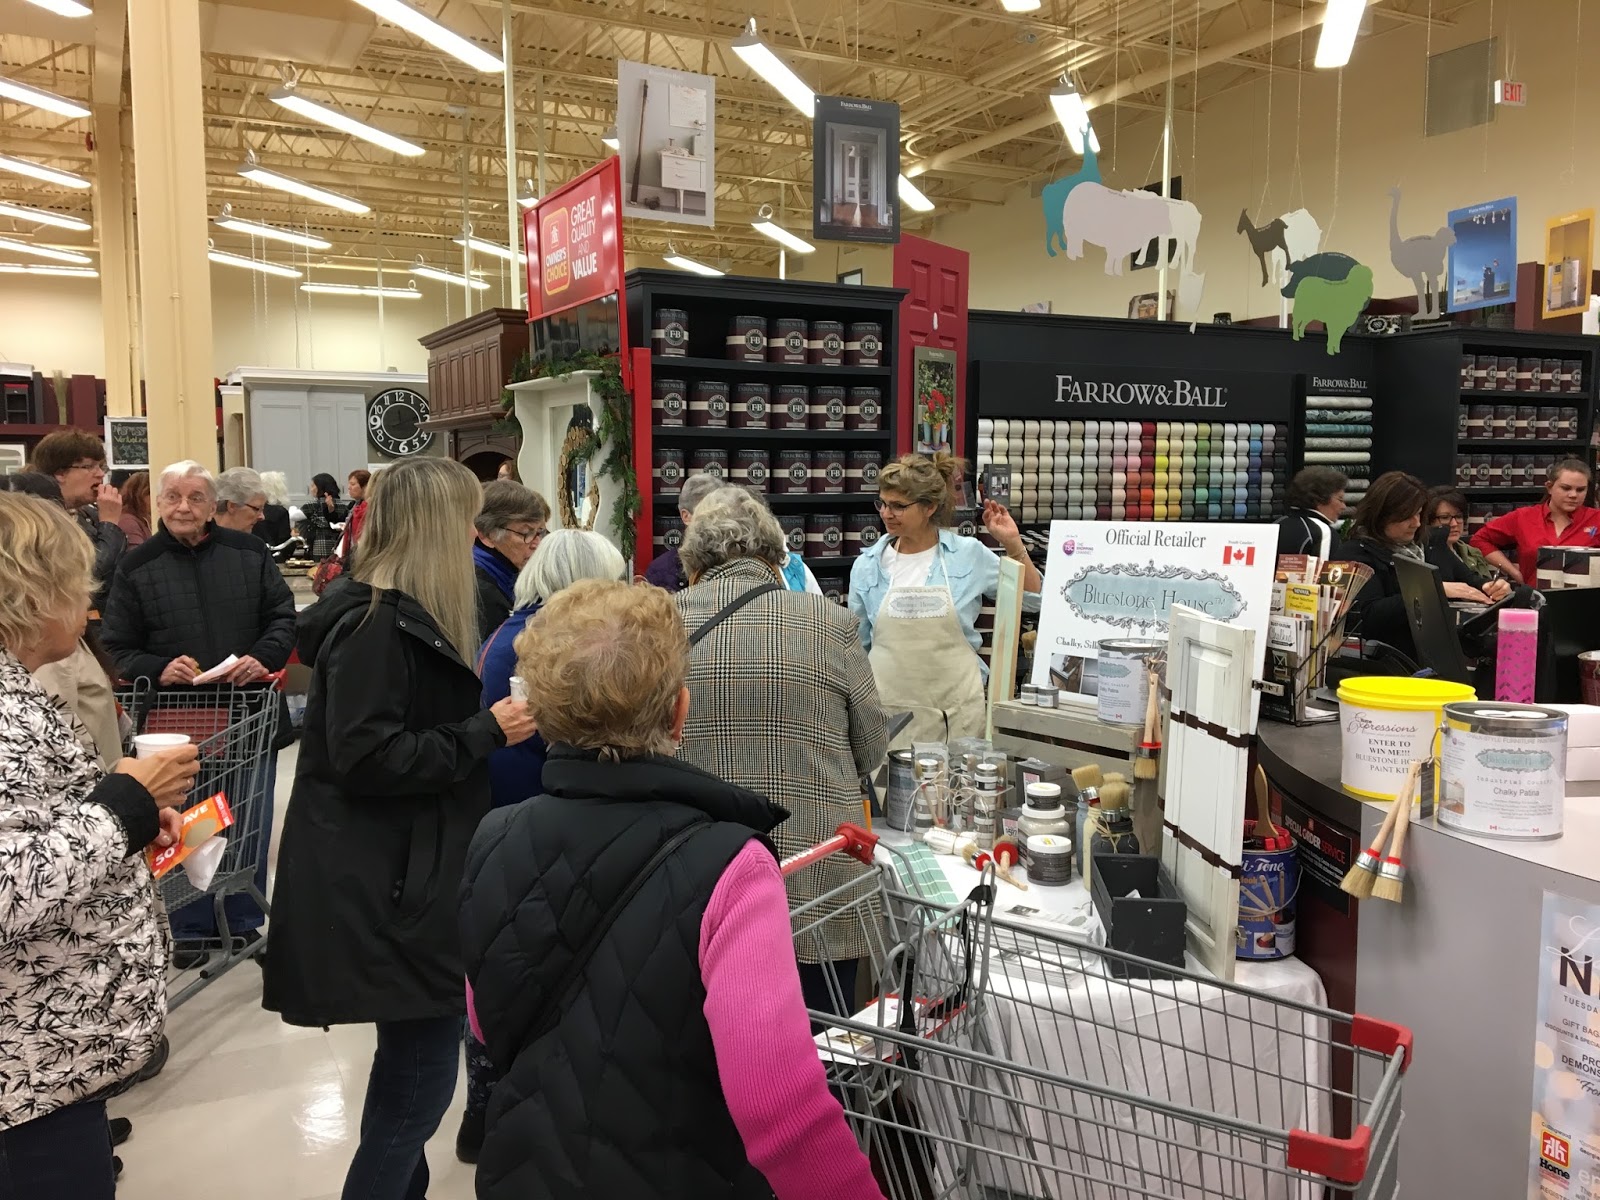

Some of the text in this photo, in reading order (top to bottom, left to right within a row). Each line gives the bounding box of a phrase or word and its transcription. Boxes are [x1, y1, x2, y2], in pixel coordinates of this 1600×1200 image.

[1504, 83, 1522, 102] EXIT
[571, 196, 596, 226] GREAT
[571, 219, 596, 244] QUALITY
[577, 241, 590, 256] AND
[545, 260, 568, 283] CHOICE
[572, 252, 598, 280] VALUE
[1312, 376, 1368, 389] FARROW&BALL
[395, 391, 405, 402] 12
[1055, 374, 1228, 408] FARROW&BALL
[383, 395, 390, 405] 11
[410, 394, 414, 405] 1
[374, 404, 383, 415] 10
[420, 403, 426, 413] 2
[370, 415, 381, 430] 9
[376, 429, 384, 442] 8
[420, 431, 428, 440] 4
[388, 440, 395, 450] 7
[399, 440, 409, 453] 6
[412, 438, 420, 450] 5
[1105, 528, 1206, 548] Official Retailer
[1083, 583, 1155, 609] Bluestone
[1056, 636, 1083, 649] Chalky,
[1368, 738, 1396, 747] ENTER
[1370, 747, 1386, 755] WIN
[1355, 753, 1398, 765] BLUESTONE
[1370, 764, 1394, 773] PAINT
[1493, 787, 1540, 797] Chalky Patina
[183, 804, 208, 826] AVE
[1285, 814, 1303, 838] SPECIAL
[1302, 828, 1321, 850] ORDER
[1321, 841, 1346, 865] SERVICE
[1240, 858, 1284, 873] i-Tone
[1563, 995, 1598, 1014] TUESDA
[1545, 1022, 1574, 1038] DISCOUNTS
[1562, 1018, 1600, 1038] GIFT BAG
[1540, 1156, 1571, 1180] Home
